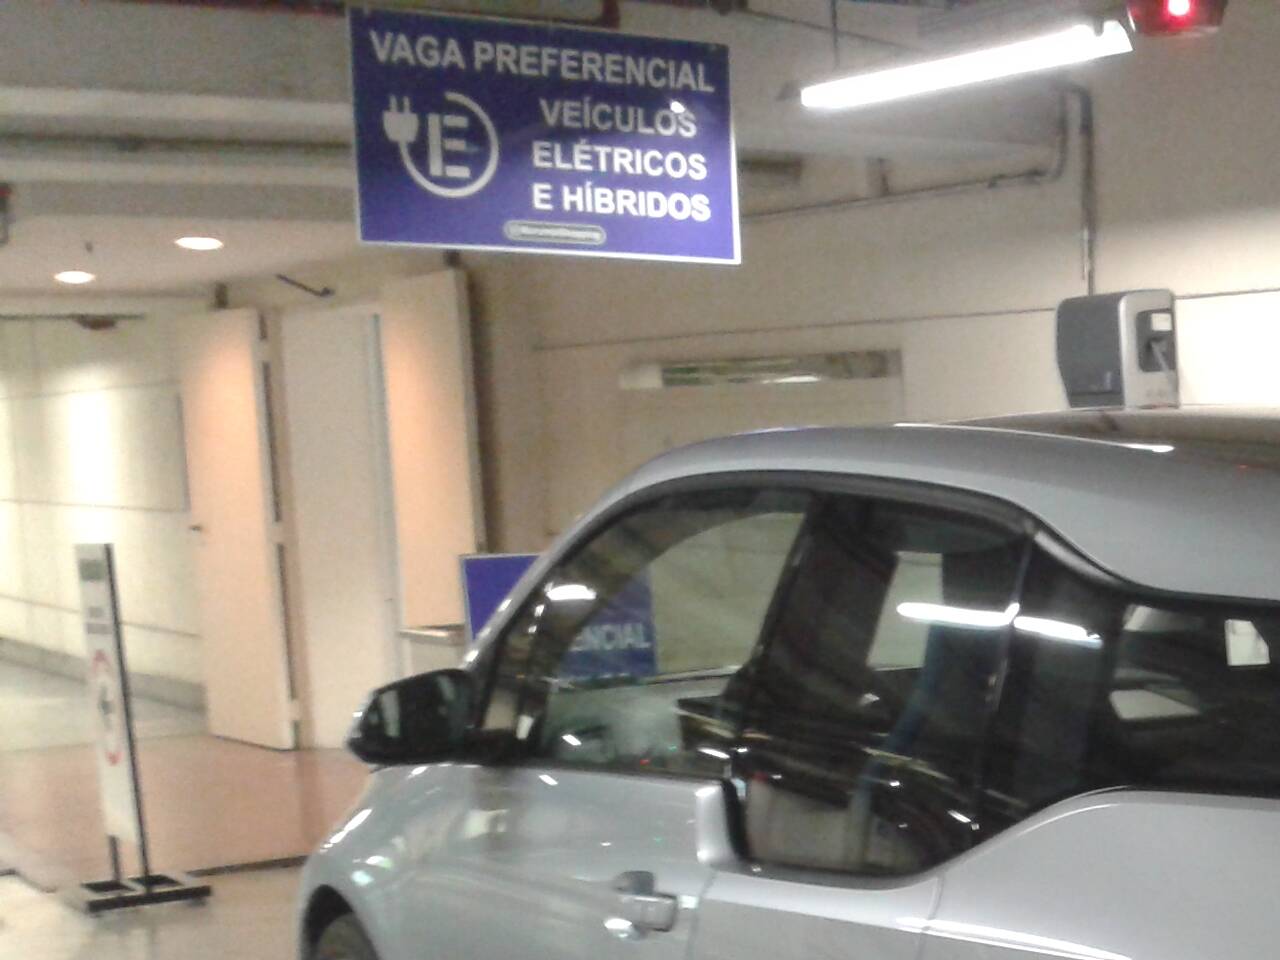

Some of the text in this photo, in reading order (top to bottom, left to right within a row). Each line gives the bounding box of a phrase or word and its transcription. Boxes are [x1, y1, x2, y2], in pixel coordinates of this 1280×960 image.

[370, 30, 715, 92] VAGA PREFERENCIAL
[539, 96, 697, 138] VEÍCULOS
[532, 139, 708, 181] ELÉTRICOS
[532, 180, 712, 222] E HÍBRIDOS
